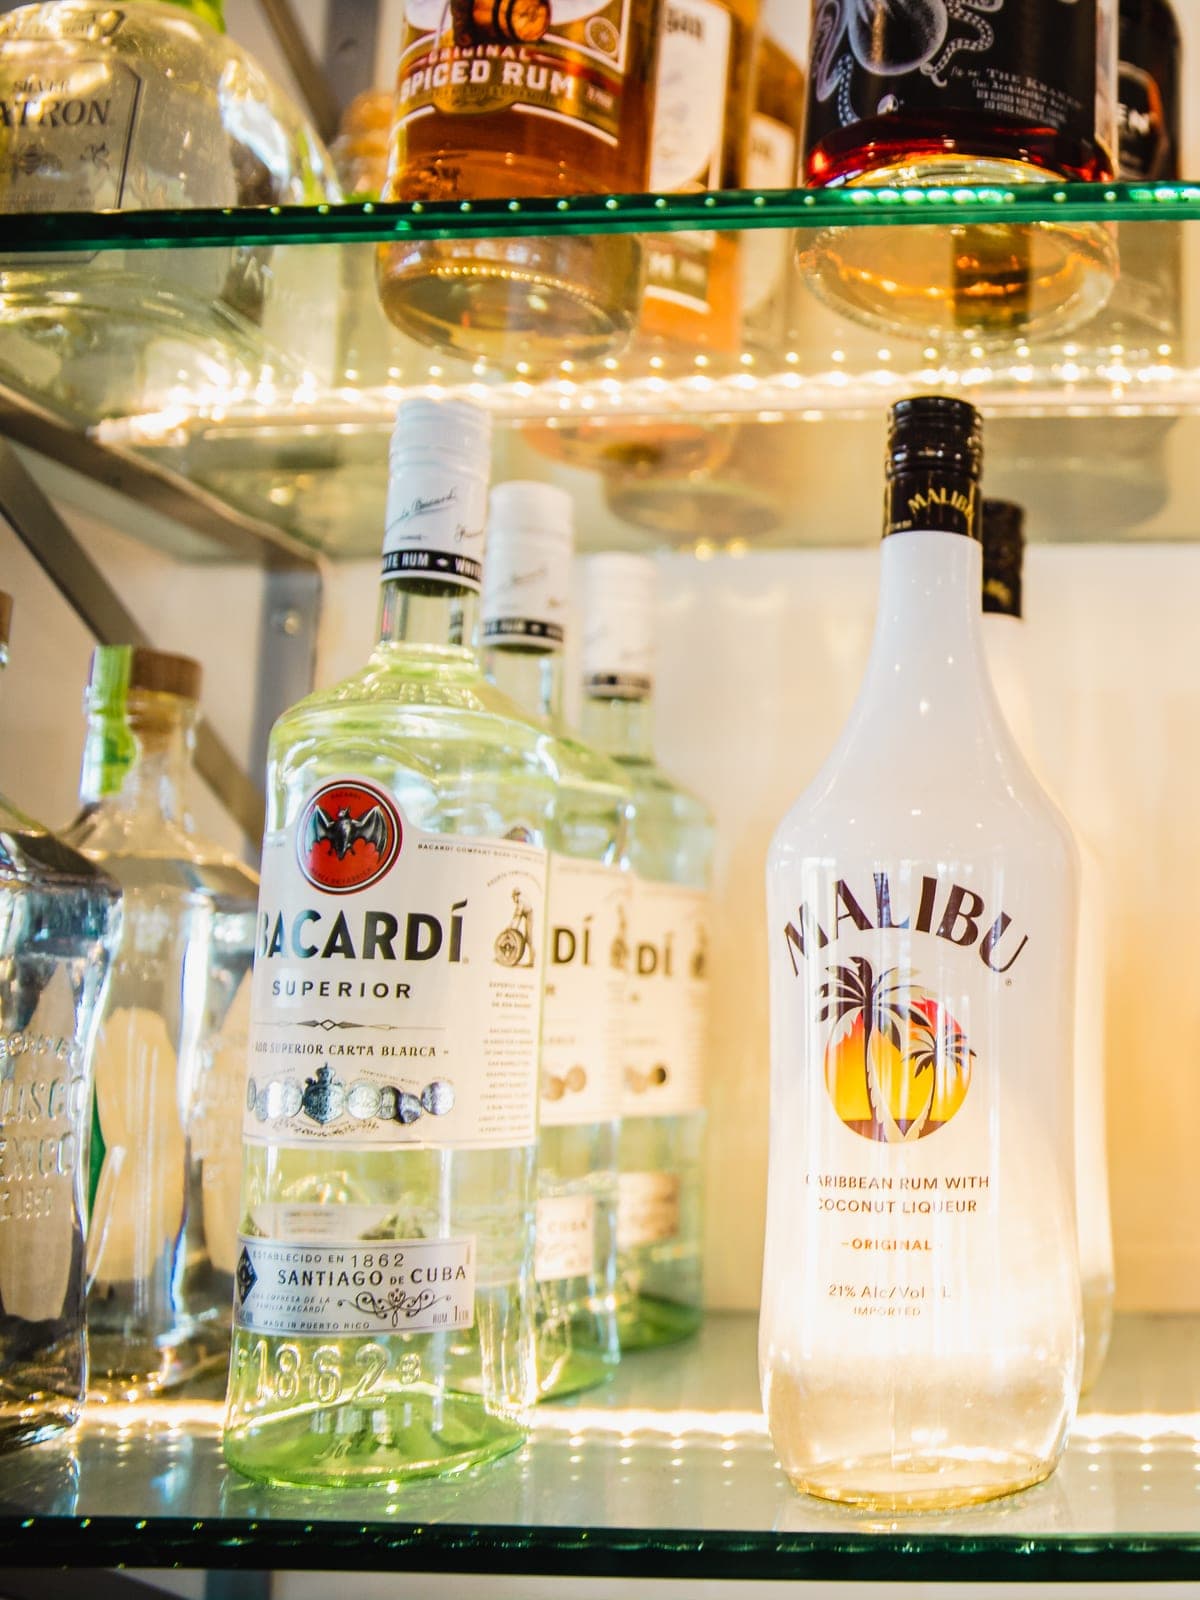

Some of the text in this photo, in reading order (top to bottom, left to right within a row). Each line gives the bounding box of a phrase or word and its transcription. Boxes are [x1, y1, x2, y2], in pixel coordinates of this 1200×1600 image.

[400, 60, 491, 104] SPICED
[502, 61, 575, 100] RUM
[402, 552, 429, 568] RUM
[784, 872, 1029, 977] MALIBU
[272, 980, 412, 999] SUPERIOR
[270, 1042, 324, 1055] SUPERIOR
[328, 1044, 374, 1057] CARTA
[381, 1045, 436, 1057] BLANCA
[806, 1174, 989, 1190] RIBBEAN RUM WITH
[902, 1200, 977, 1214] LIQUEUR
[253, 1250, 405, 1268] ESTABLECIDO EN 1862
[278, 1265, 466, 1287] SANTIAGO DE CUBA
[829, 1284, 856, 1298] 21%
[861, 1285, 925, 1299] Alc/Vol
[300, 1320, 339, 1329] PUERTO
[344, 1319, 370, 1329] RICO
